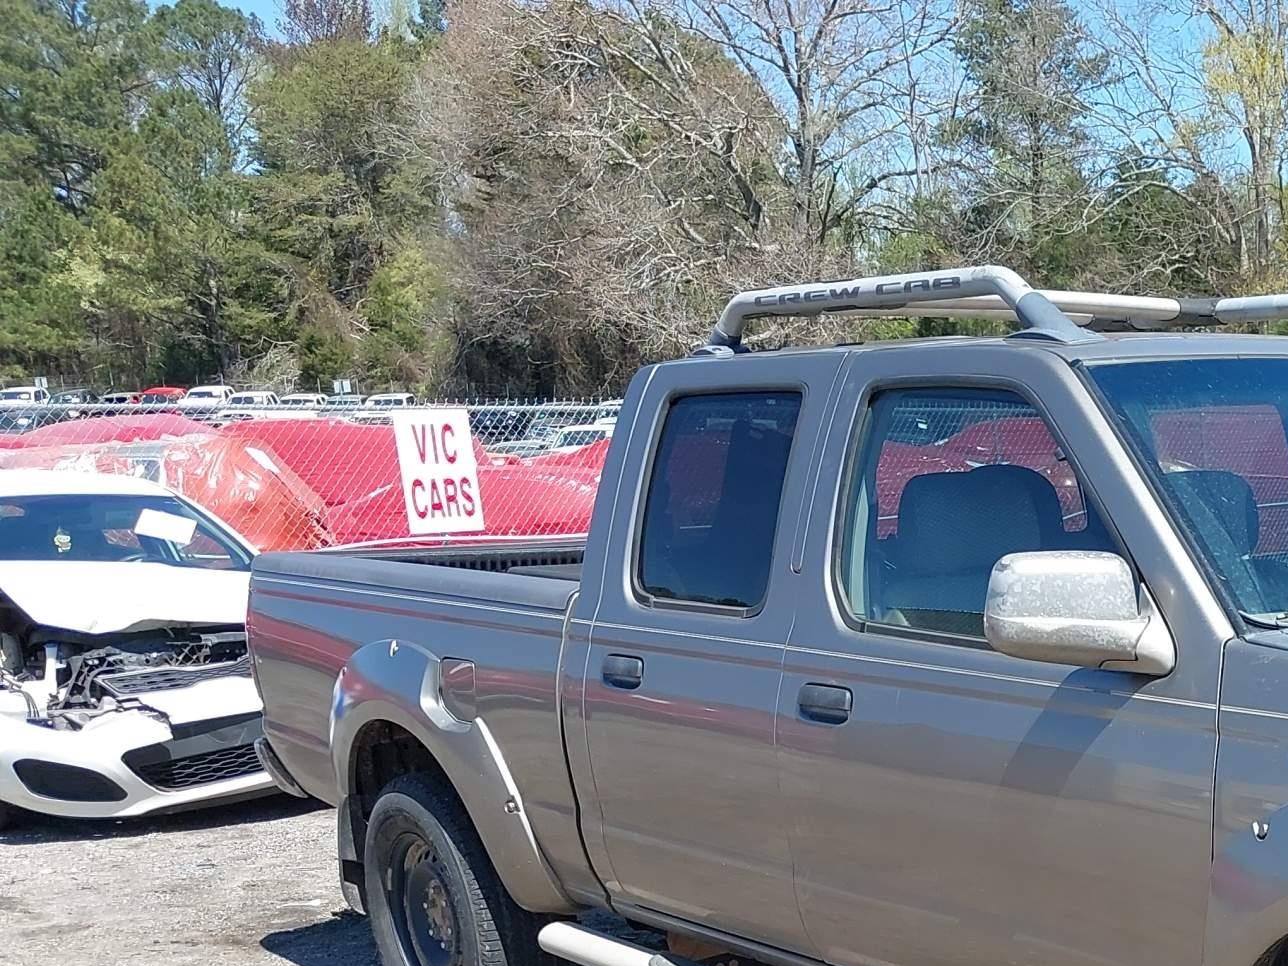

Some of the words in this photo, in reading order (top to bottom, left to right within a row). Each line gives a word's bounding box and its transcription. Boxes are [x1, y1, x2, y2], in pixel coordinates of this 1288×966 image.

[753, 285, 861, 308] CREW
[874, 275, 961, 297] CAB
[410, 423, 458, 465] VIC
[411, 476, 476, 520] CARS
